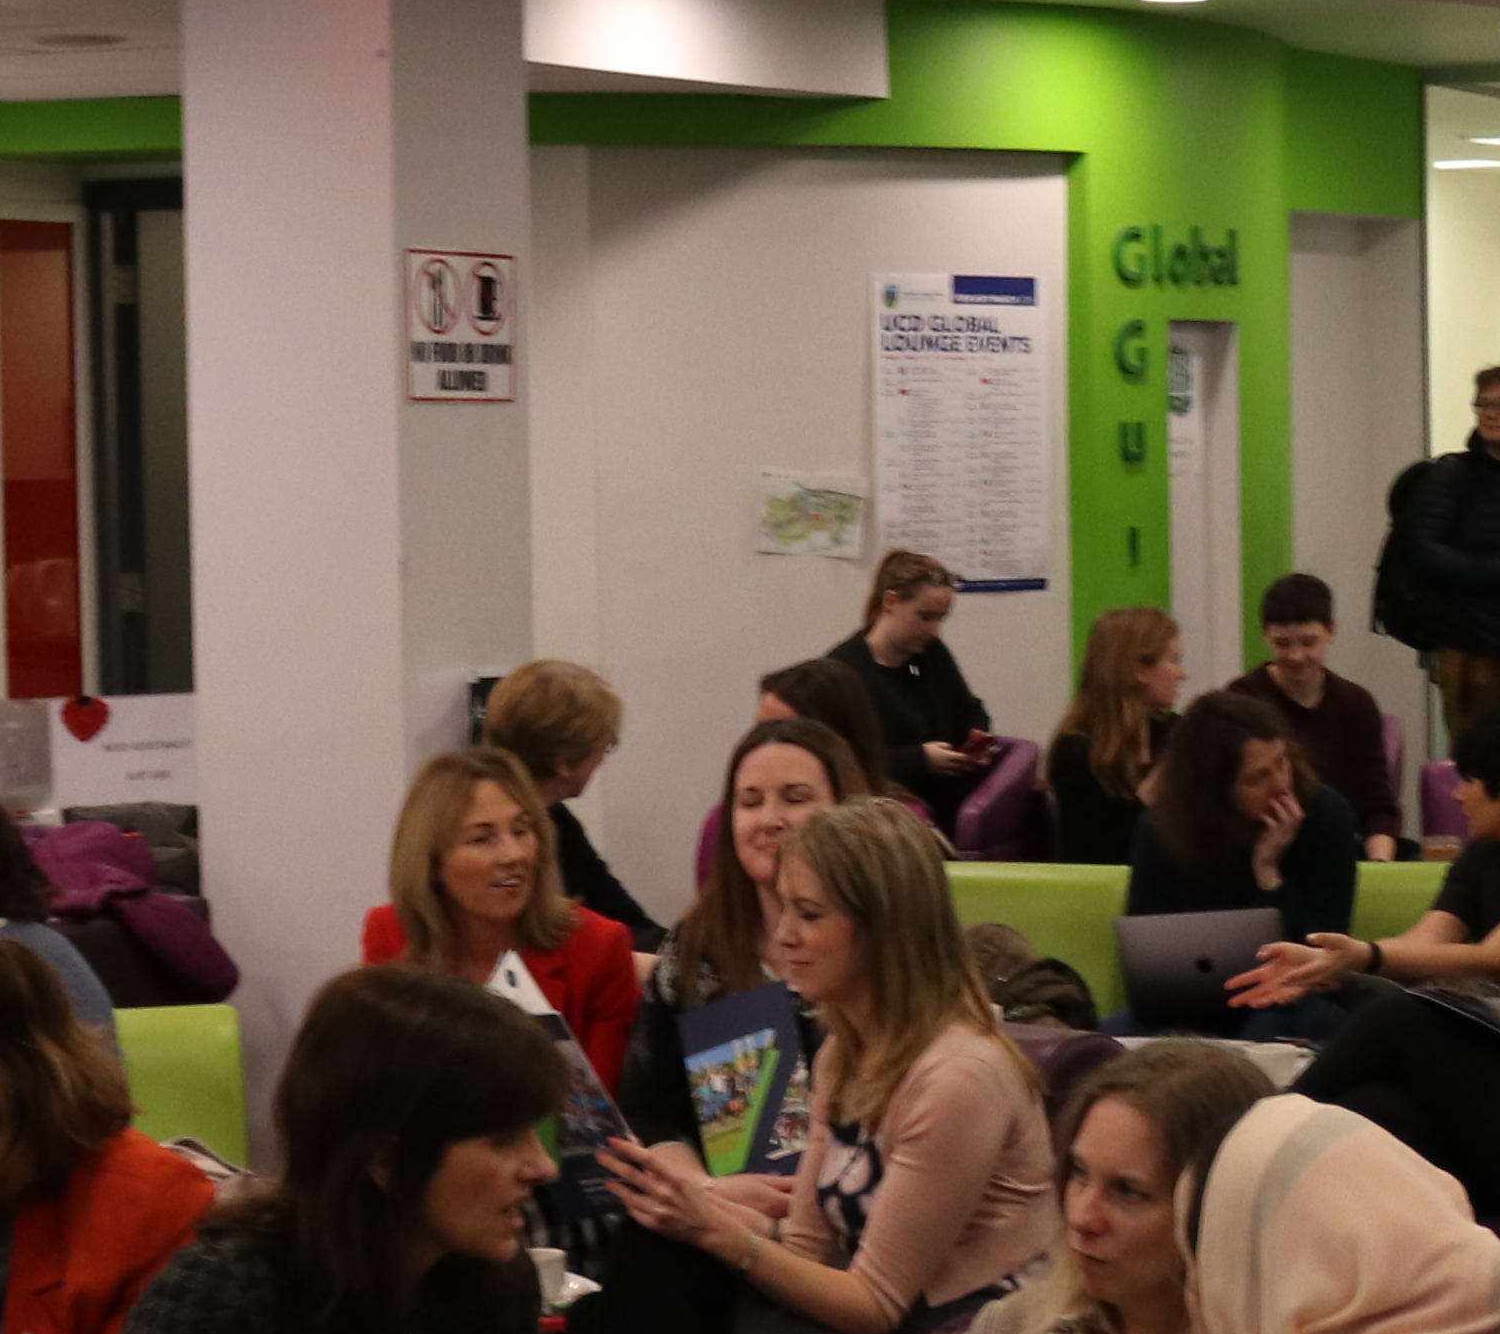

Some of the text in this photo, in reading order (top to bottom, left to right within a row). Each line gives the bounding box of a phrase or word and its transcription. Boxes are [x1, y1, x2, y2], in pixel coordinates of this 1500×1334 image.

[1112, 225, 1238, 288] Global
[880, 315, 1001, 334] UCD GLOBAL
[880, 334, 1033, 355] LOUNGE EVENTS
